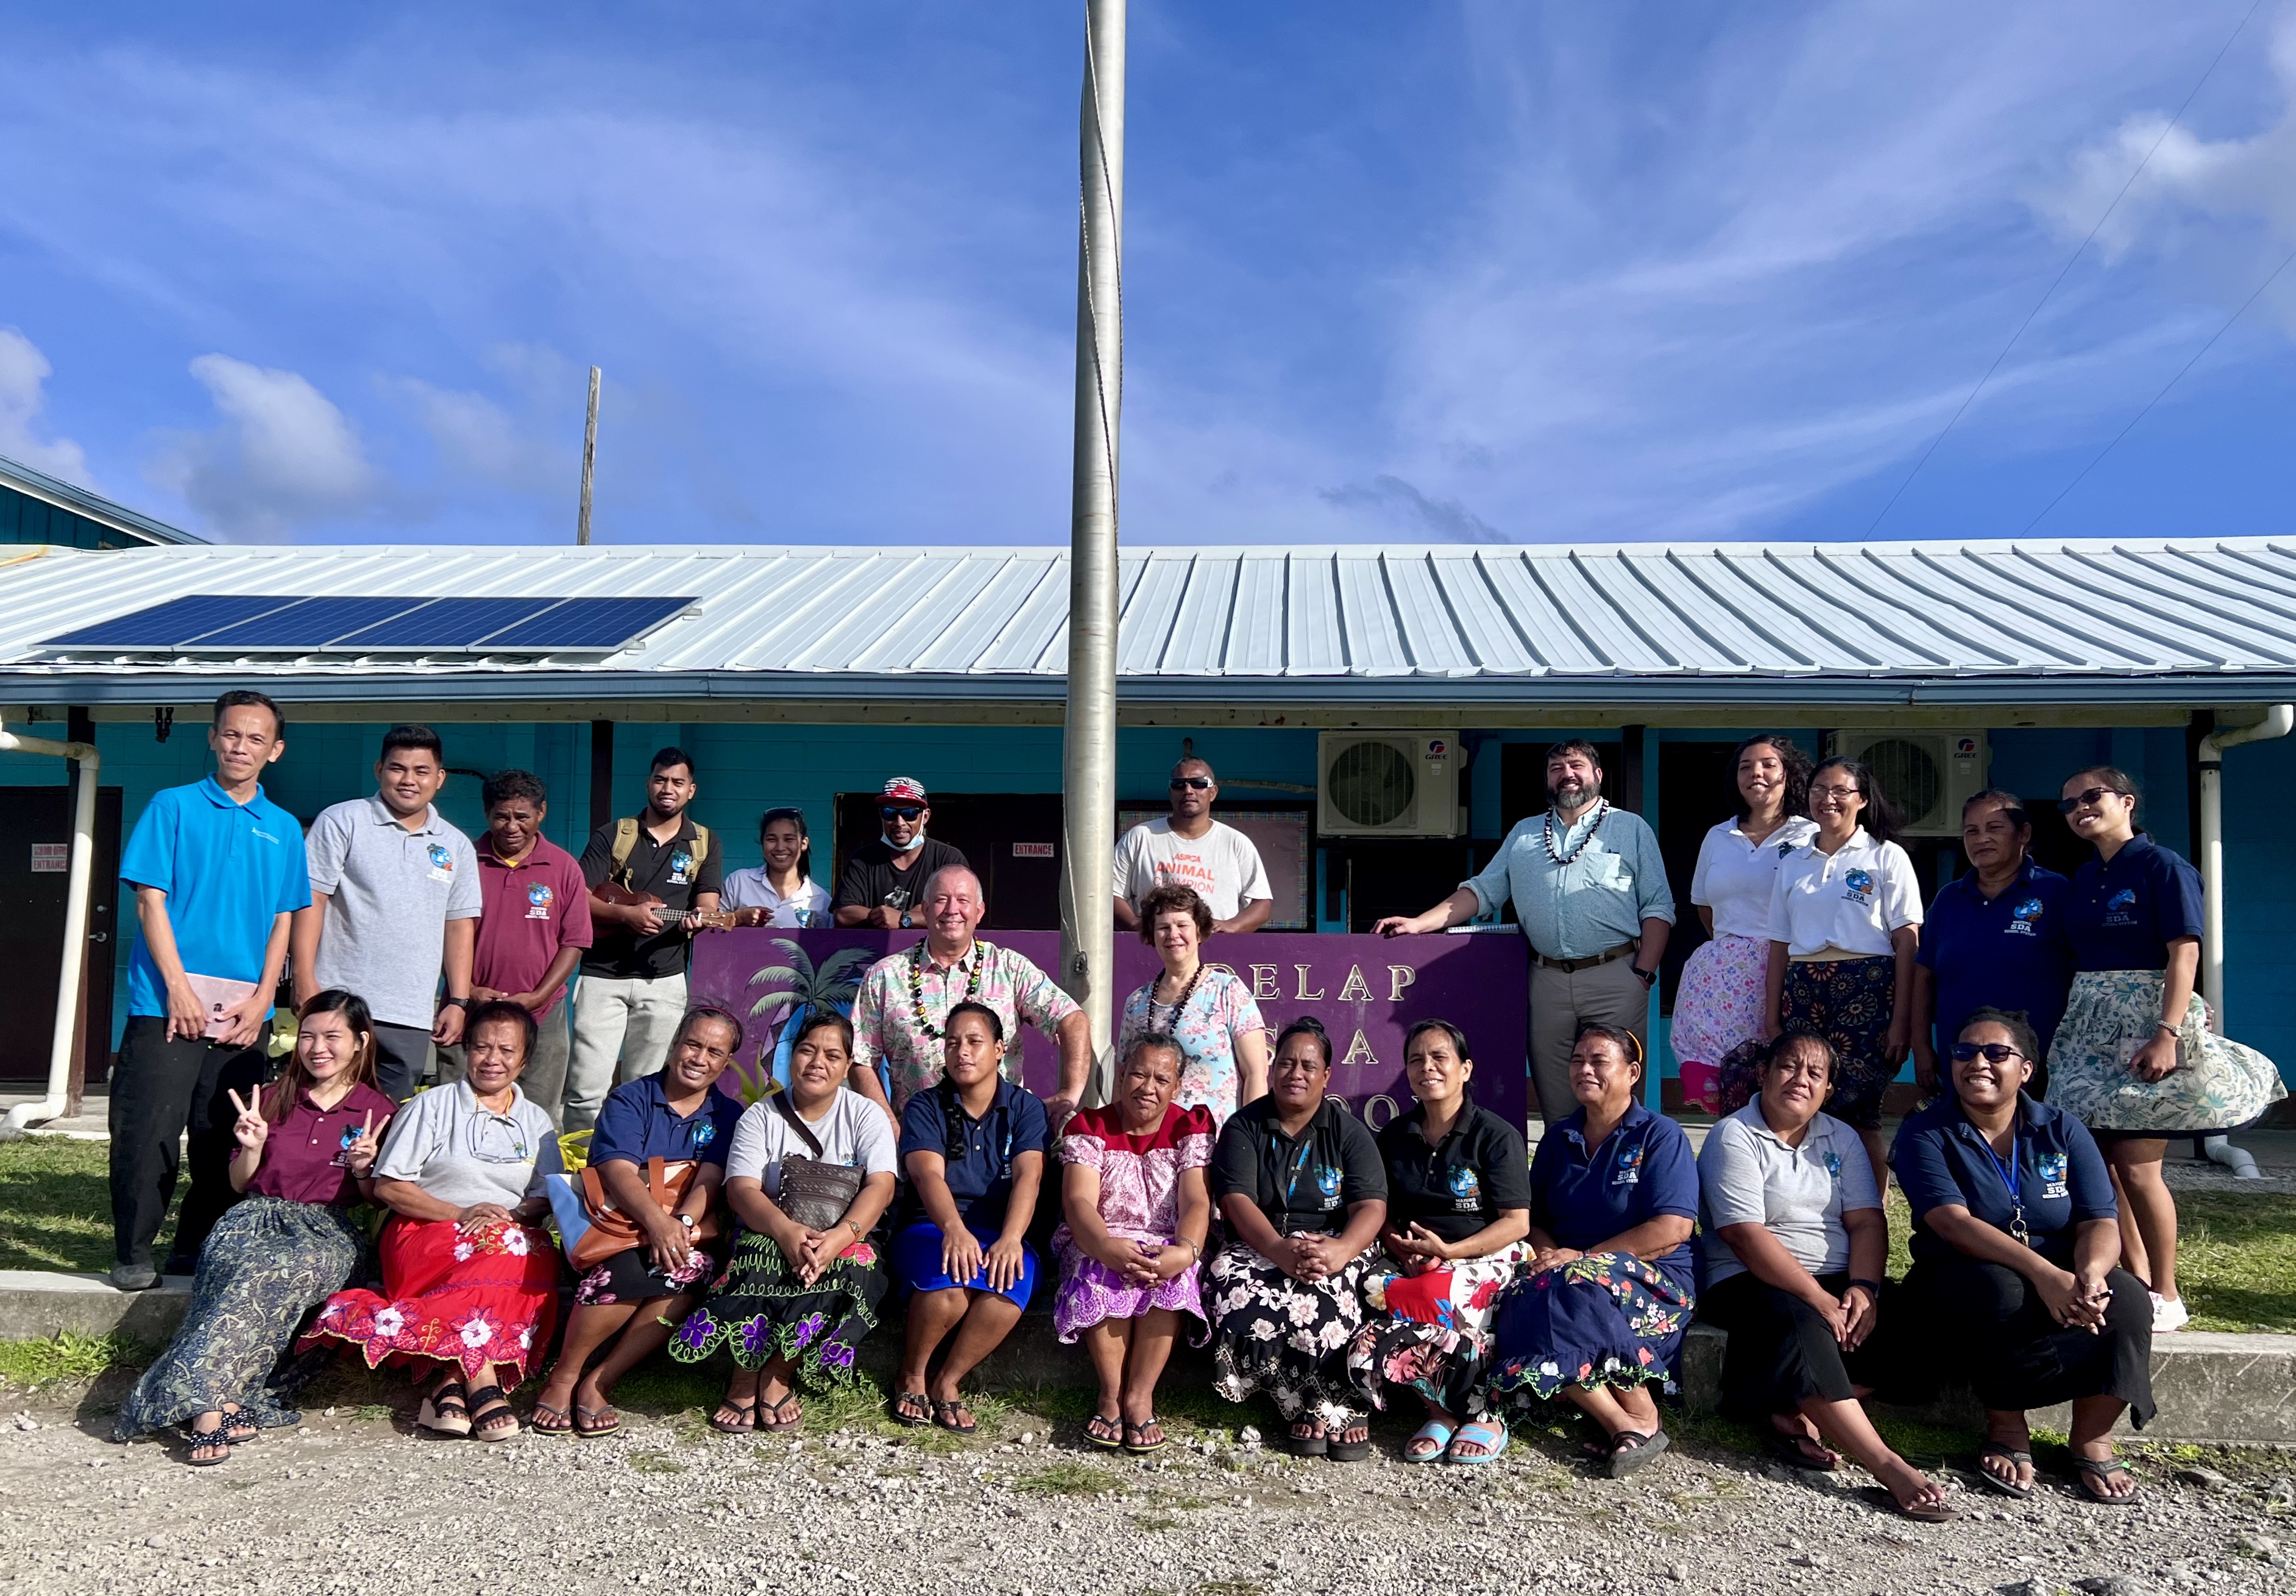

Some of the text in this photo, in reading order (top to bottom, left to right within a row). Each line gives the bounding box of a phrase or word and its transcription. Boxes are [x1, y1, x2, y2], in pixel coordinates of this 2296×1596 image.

[1015, 845, 1052, 855] ENTRANCE
[1174, 853, 1200, 863] ASPCA
[1155, 861, 1214, 881] ANIMAL
[1846, 892, 1865, 902] SDA
[2010, 923, 2031, 932] SDA
[1617, 1172, 1637, 1181] SDA
